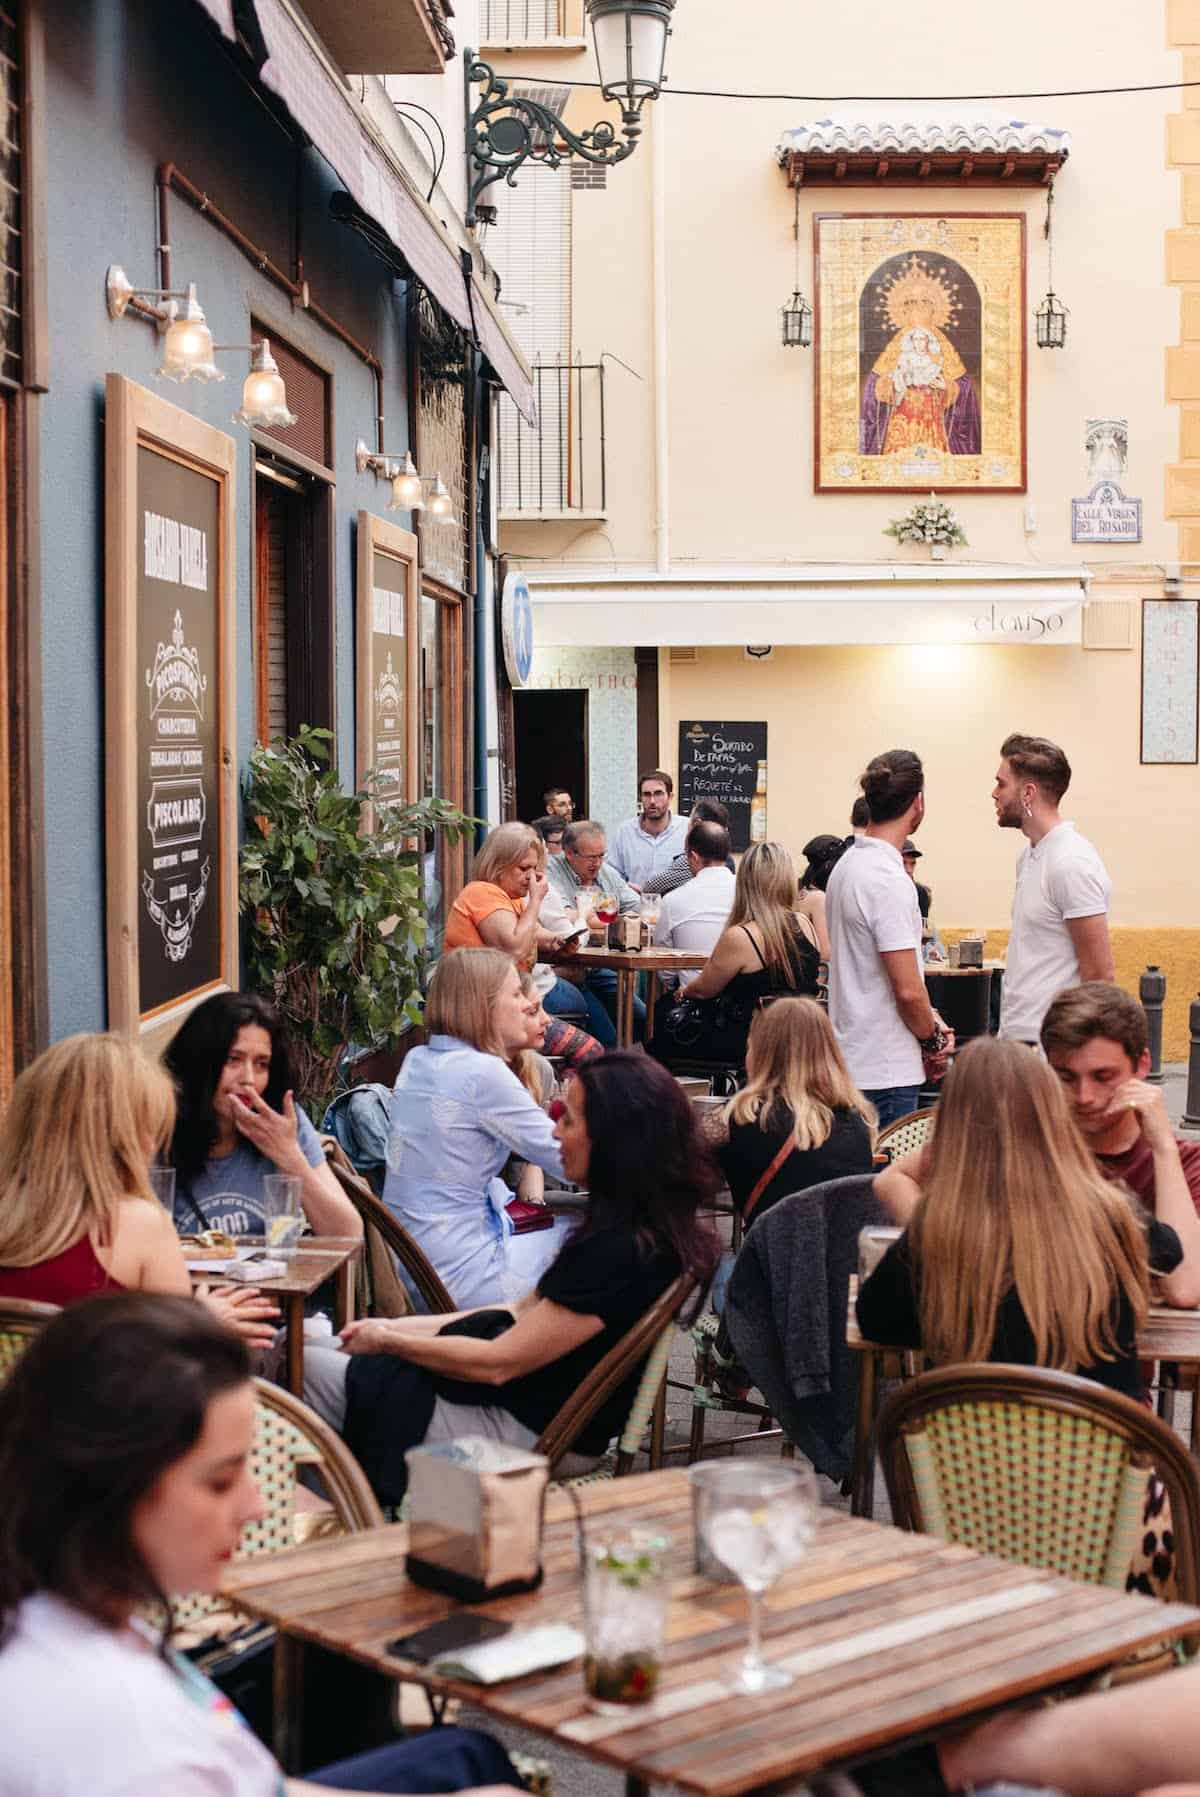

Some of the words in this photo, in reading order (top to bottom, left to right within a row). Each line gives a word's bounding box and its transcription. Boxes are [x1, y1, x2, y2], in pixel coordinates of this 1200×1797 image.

[1076, 506, 1102, 519] CALLE
[1105, 505, 1137, 519] VIRGEN
[1076, 520, 1096, 533] DEL
[1099, 519, 1137, 534] ROSARIO
